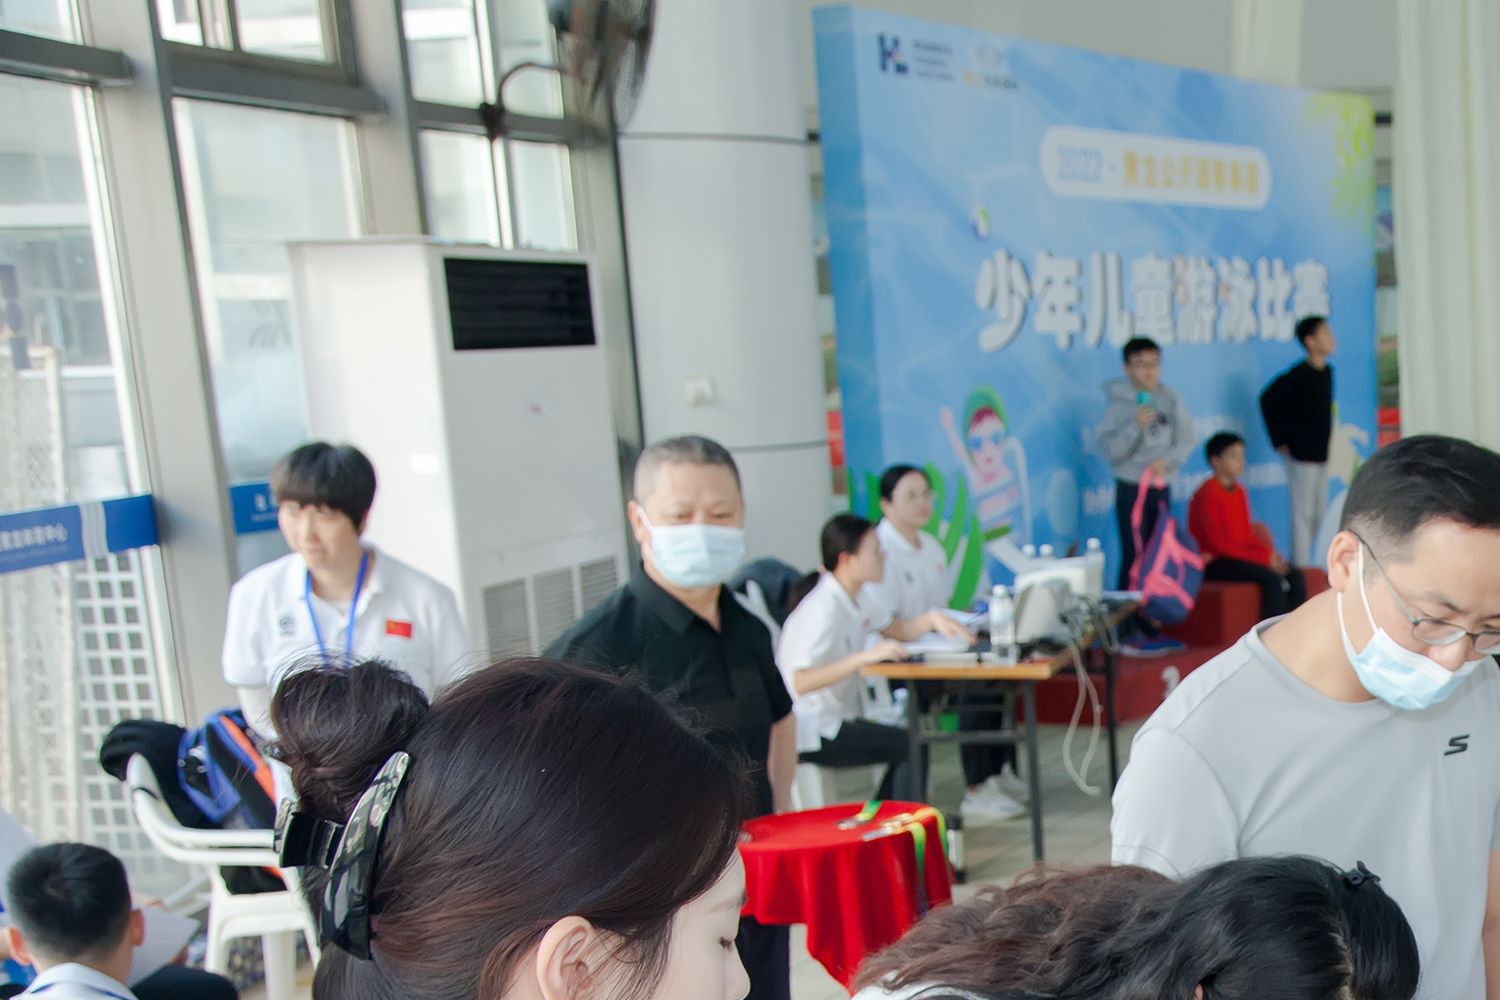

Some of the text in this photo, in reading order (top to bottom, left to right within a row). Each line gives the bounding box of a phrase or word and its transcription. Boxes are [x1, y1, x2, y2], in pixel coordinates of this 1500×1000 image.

[975, 248, 1330, 353] 少年儿童游泳比赛
